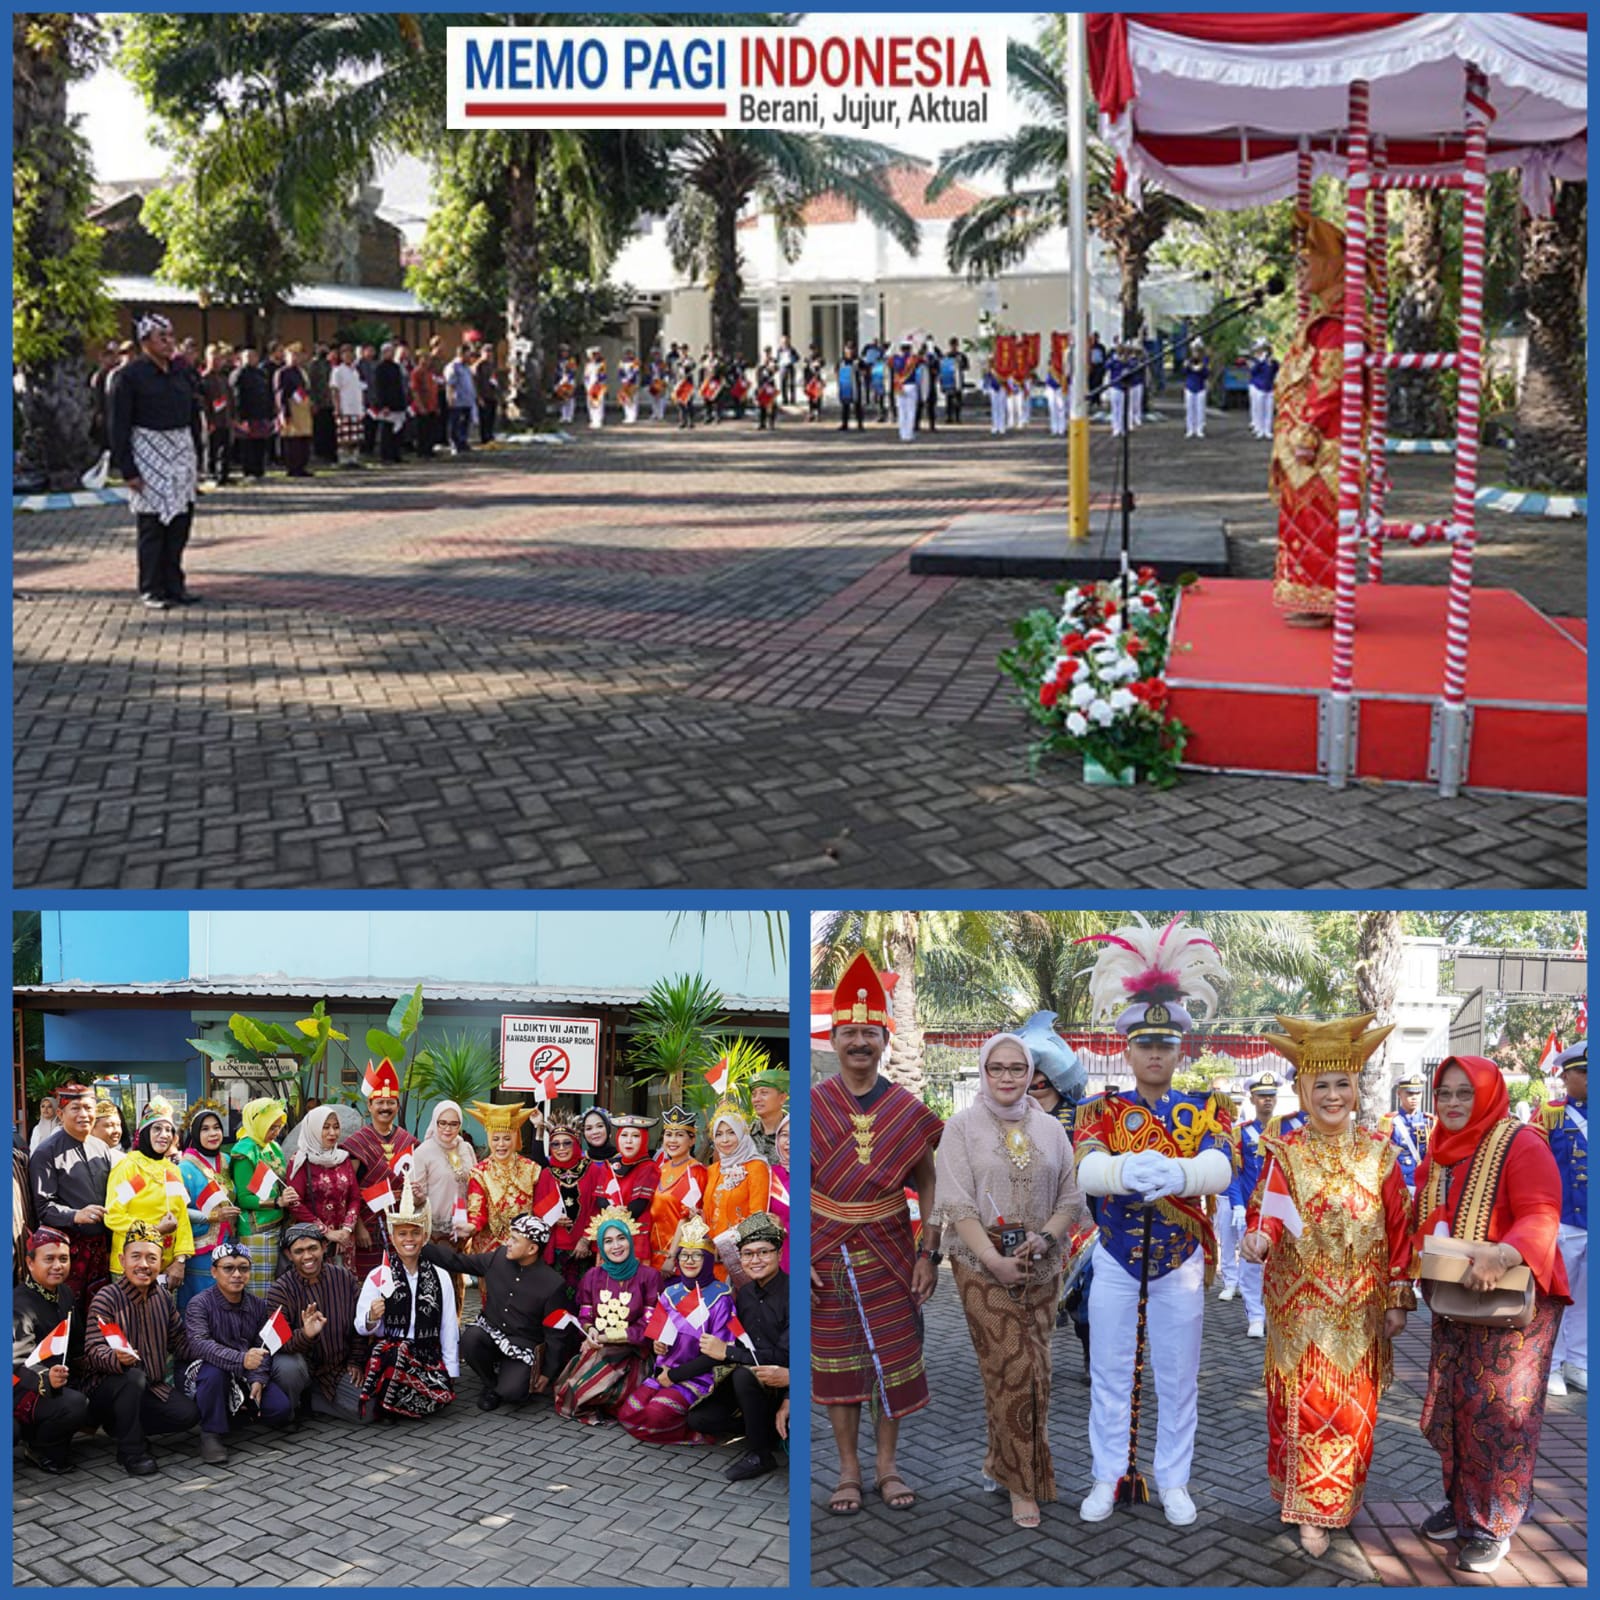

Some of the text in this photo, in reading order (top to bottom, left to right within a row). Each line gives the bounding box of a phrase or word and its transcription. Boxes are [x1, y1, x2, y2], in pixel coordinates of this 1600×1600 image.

[513, 1023, 589, 1035] LLDIKTI VII JATIM
[506, 1034, 595, 1046] KAWASAN BEBAS ASAP ROKOK
